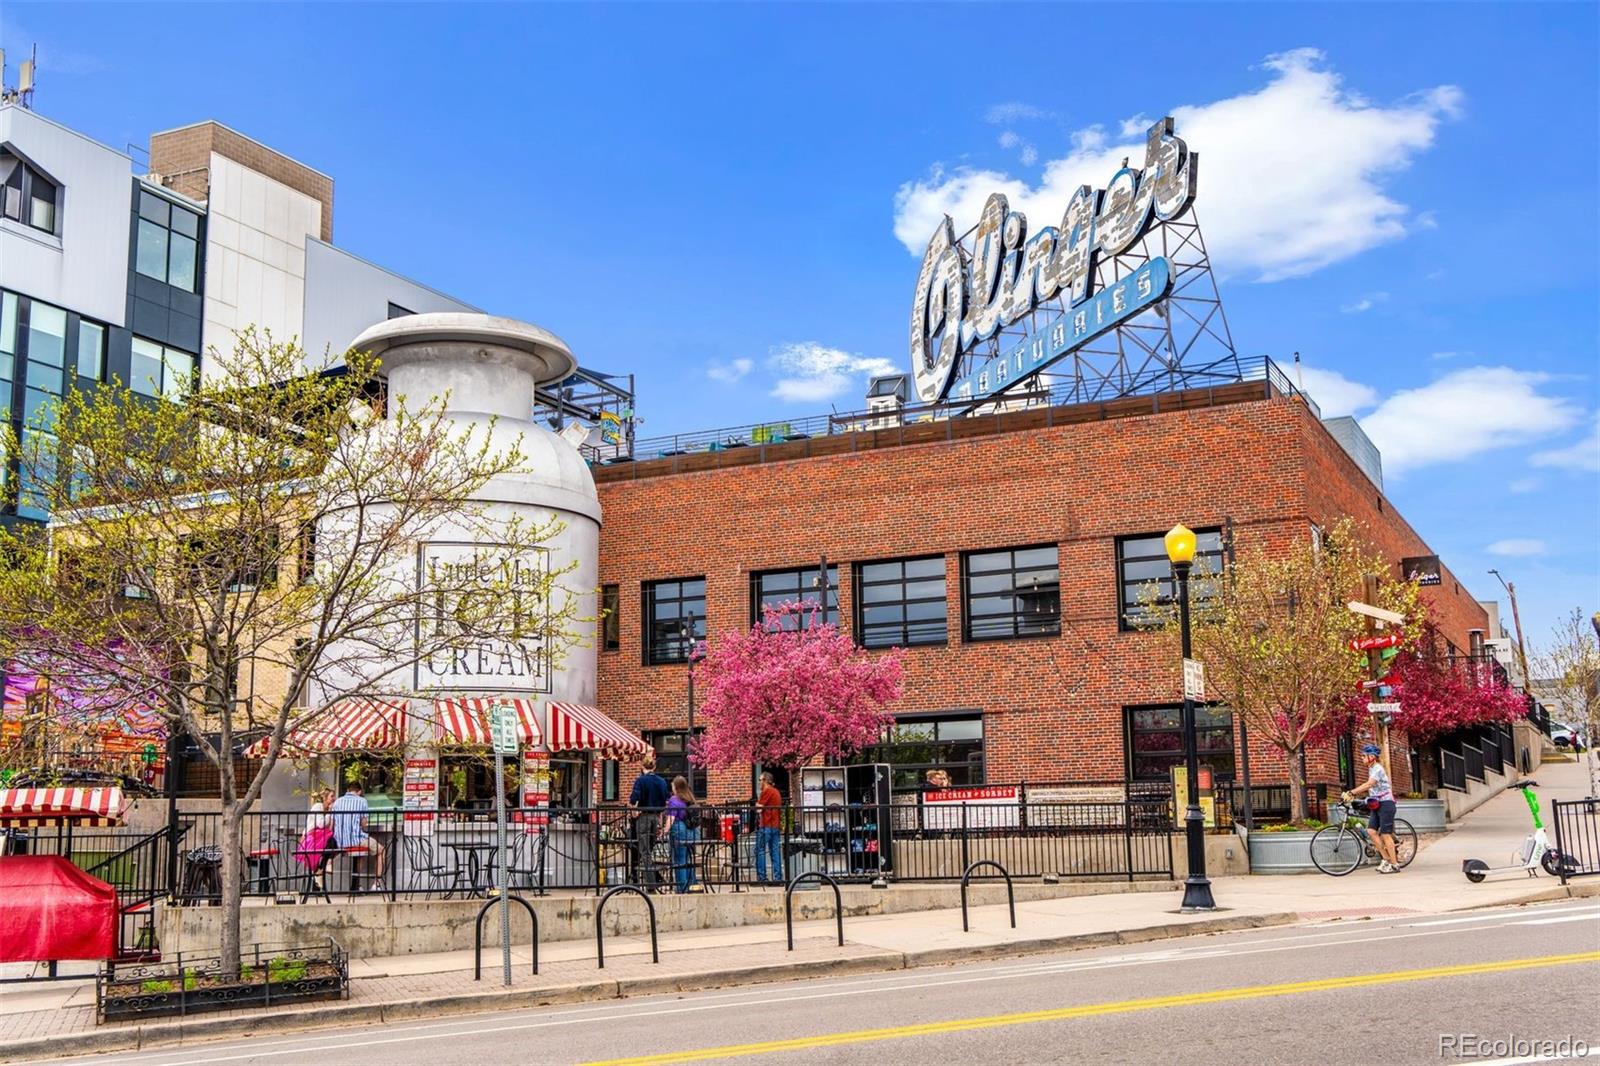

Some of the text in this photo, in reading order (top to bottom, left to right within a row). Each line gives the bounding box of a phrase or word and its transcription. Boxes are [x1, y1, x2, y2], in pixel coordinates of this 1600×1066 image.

[430, 553, 491, 584] Little
[429, 589, 544, 641] ICE
[427, 642, 543, 679] CREAM
[947, 790, 973, 799] CREAM
[980, 788, 1013, 796] SORBET
